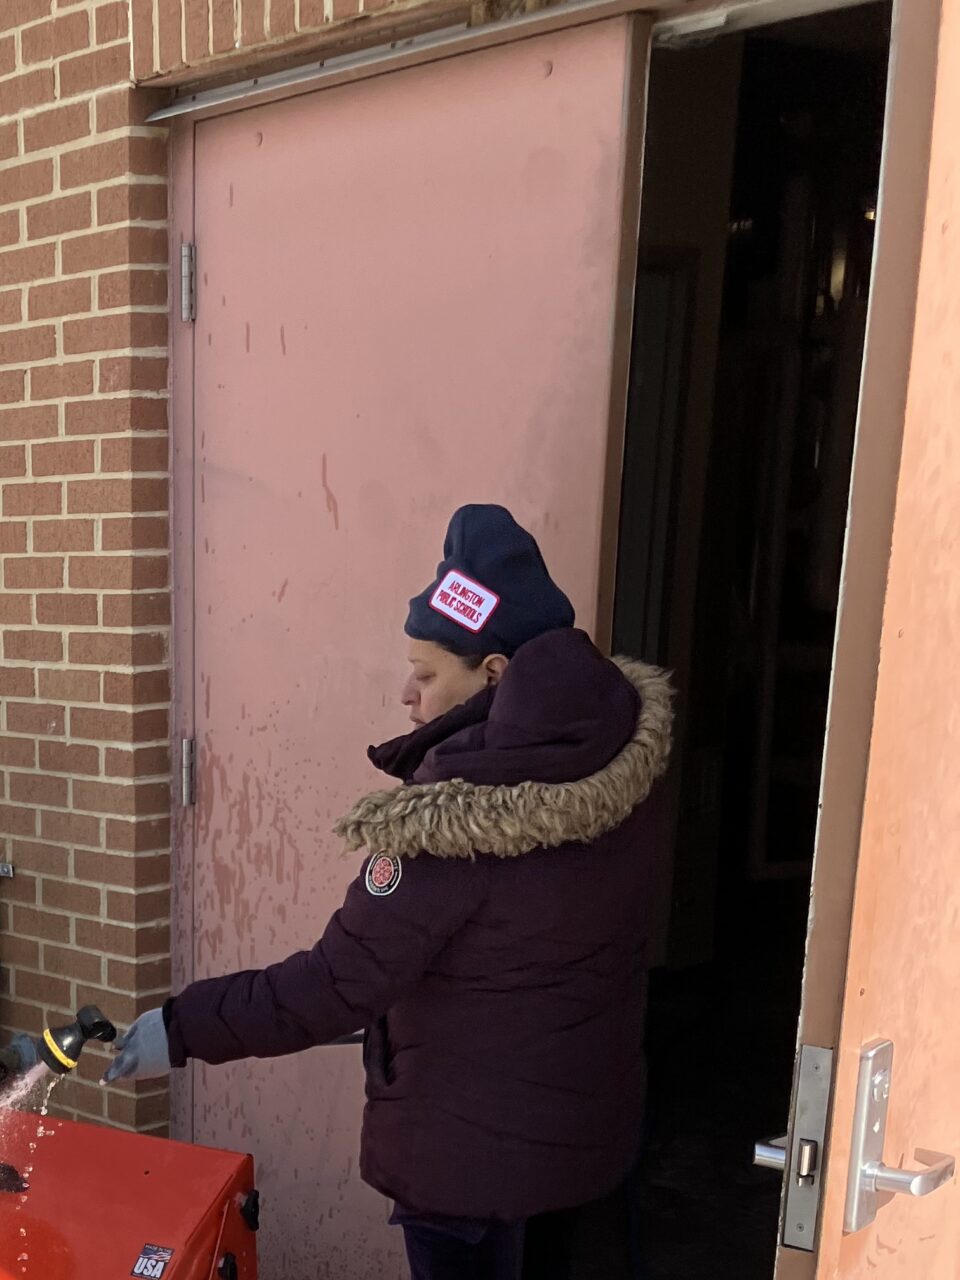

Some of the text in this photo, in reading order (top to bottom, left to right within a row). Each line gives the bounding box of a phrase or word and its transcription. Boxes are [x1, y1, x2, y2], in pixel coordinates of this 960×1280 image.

[436, 589, 483, 624] PUBLIC SCHOOLS
[448, 580, 486, 609] ARLINGTON
[133, 1257, 165, 1279] USA
